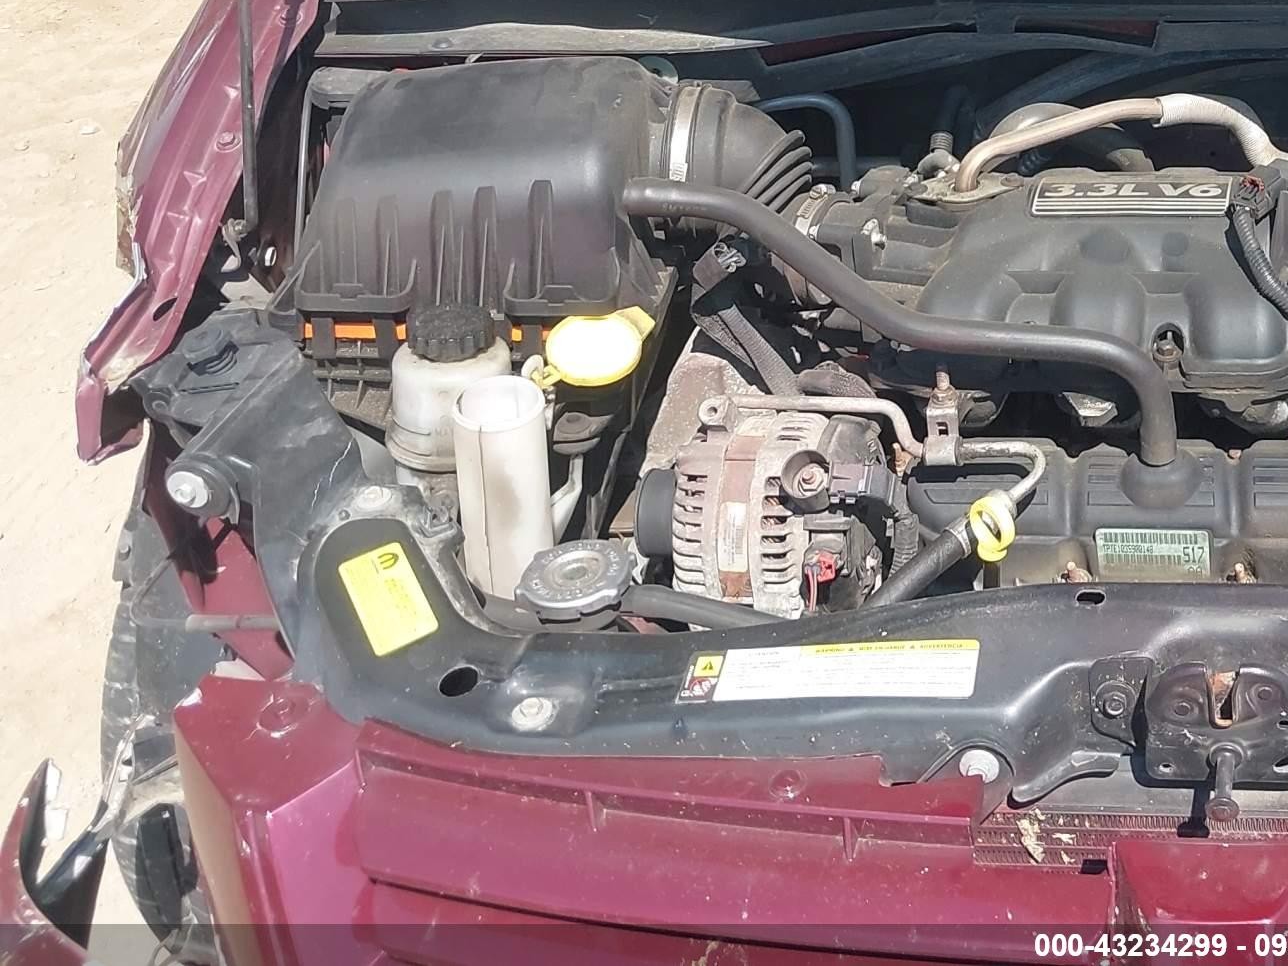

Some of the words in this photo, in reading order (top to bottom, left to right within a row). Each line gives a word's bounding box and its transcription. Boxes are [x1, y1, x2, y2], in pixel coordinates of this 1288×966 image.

[1044, 183, 1149, 197] 3.3L
[1157, 183, 1222, 197] V6
[1182, 546, 1205, 564] 517
